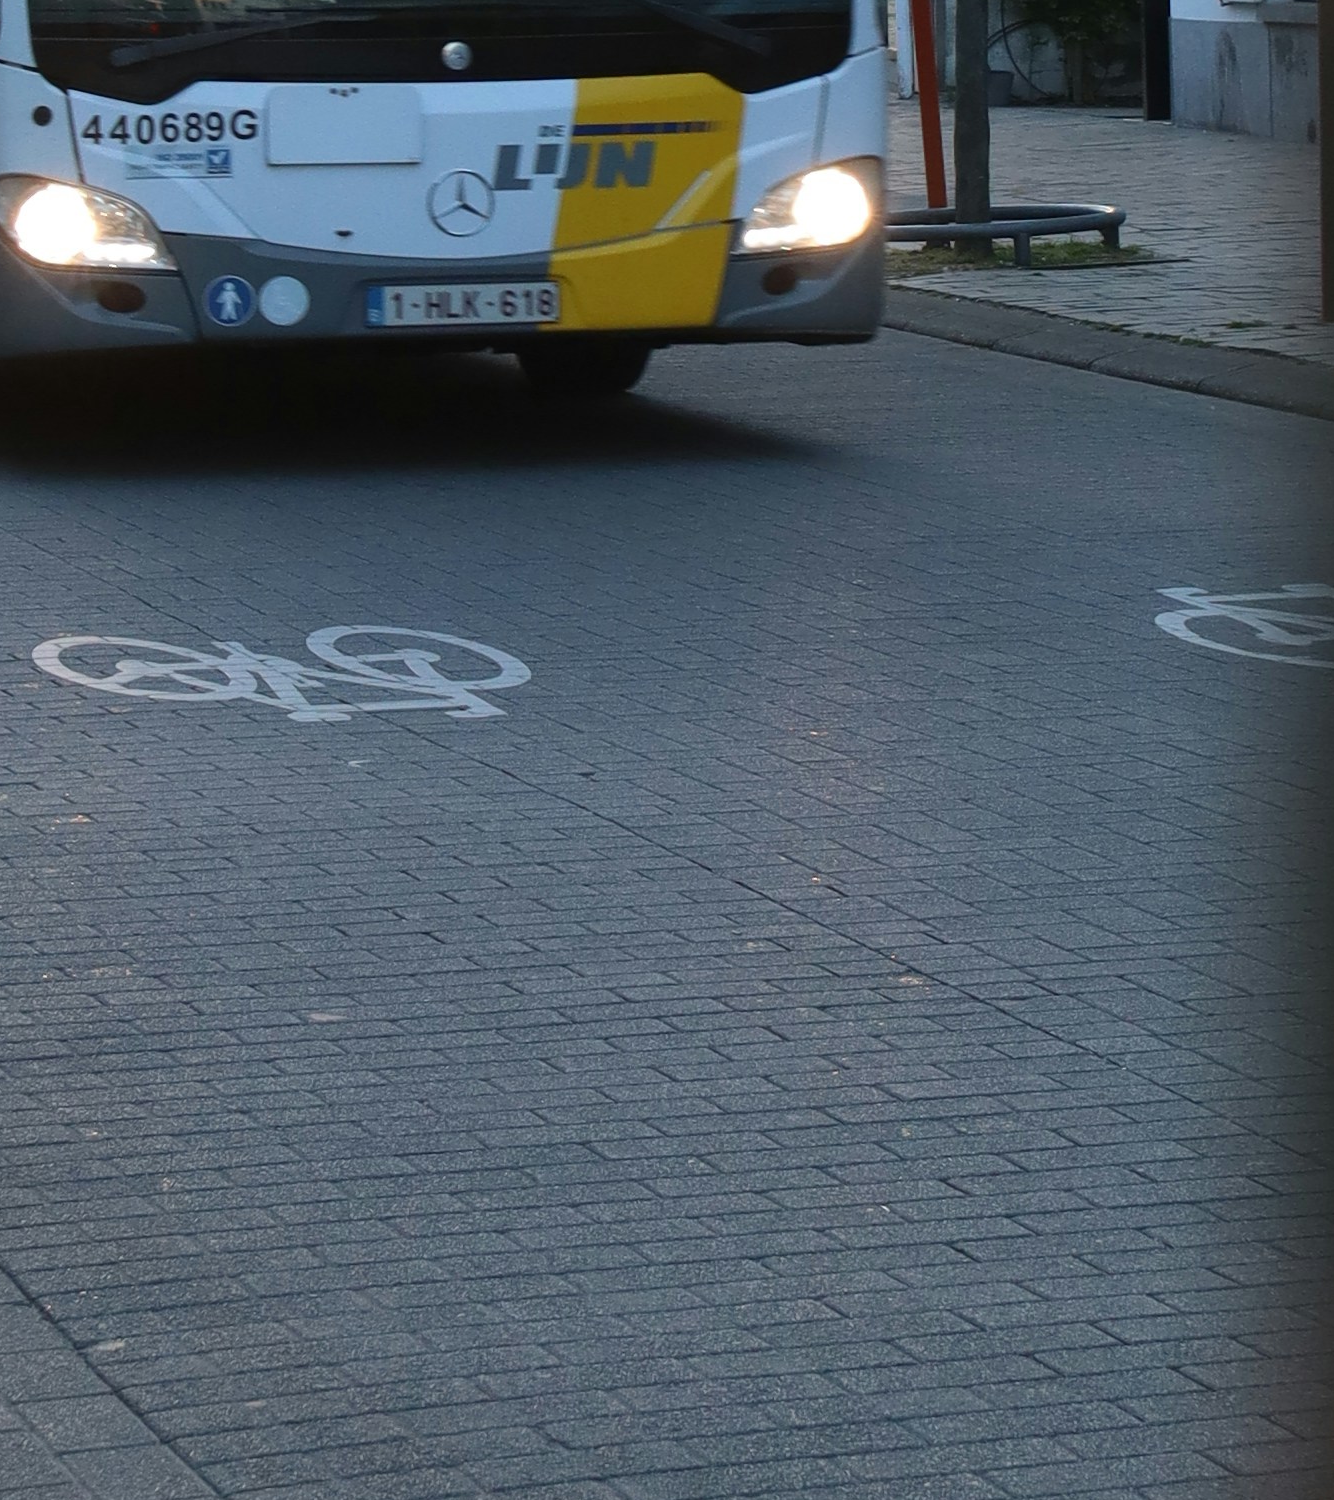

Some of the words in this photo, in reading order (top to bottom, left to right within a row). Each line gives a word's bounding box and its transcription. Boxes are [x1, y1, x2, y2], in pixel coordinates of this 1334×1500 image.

[82, 110, 259, 145] 440689G
[538, 124, 566, 137] DE
[493, 141, 658, 191] LIJN
[391, 288, 555, 320] 1-HLK-618
